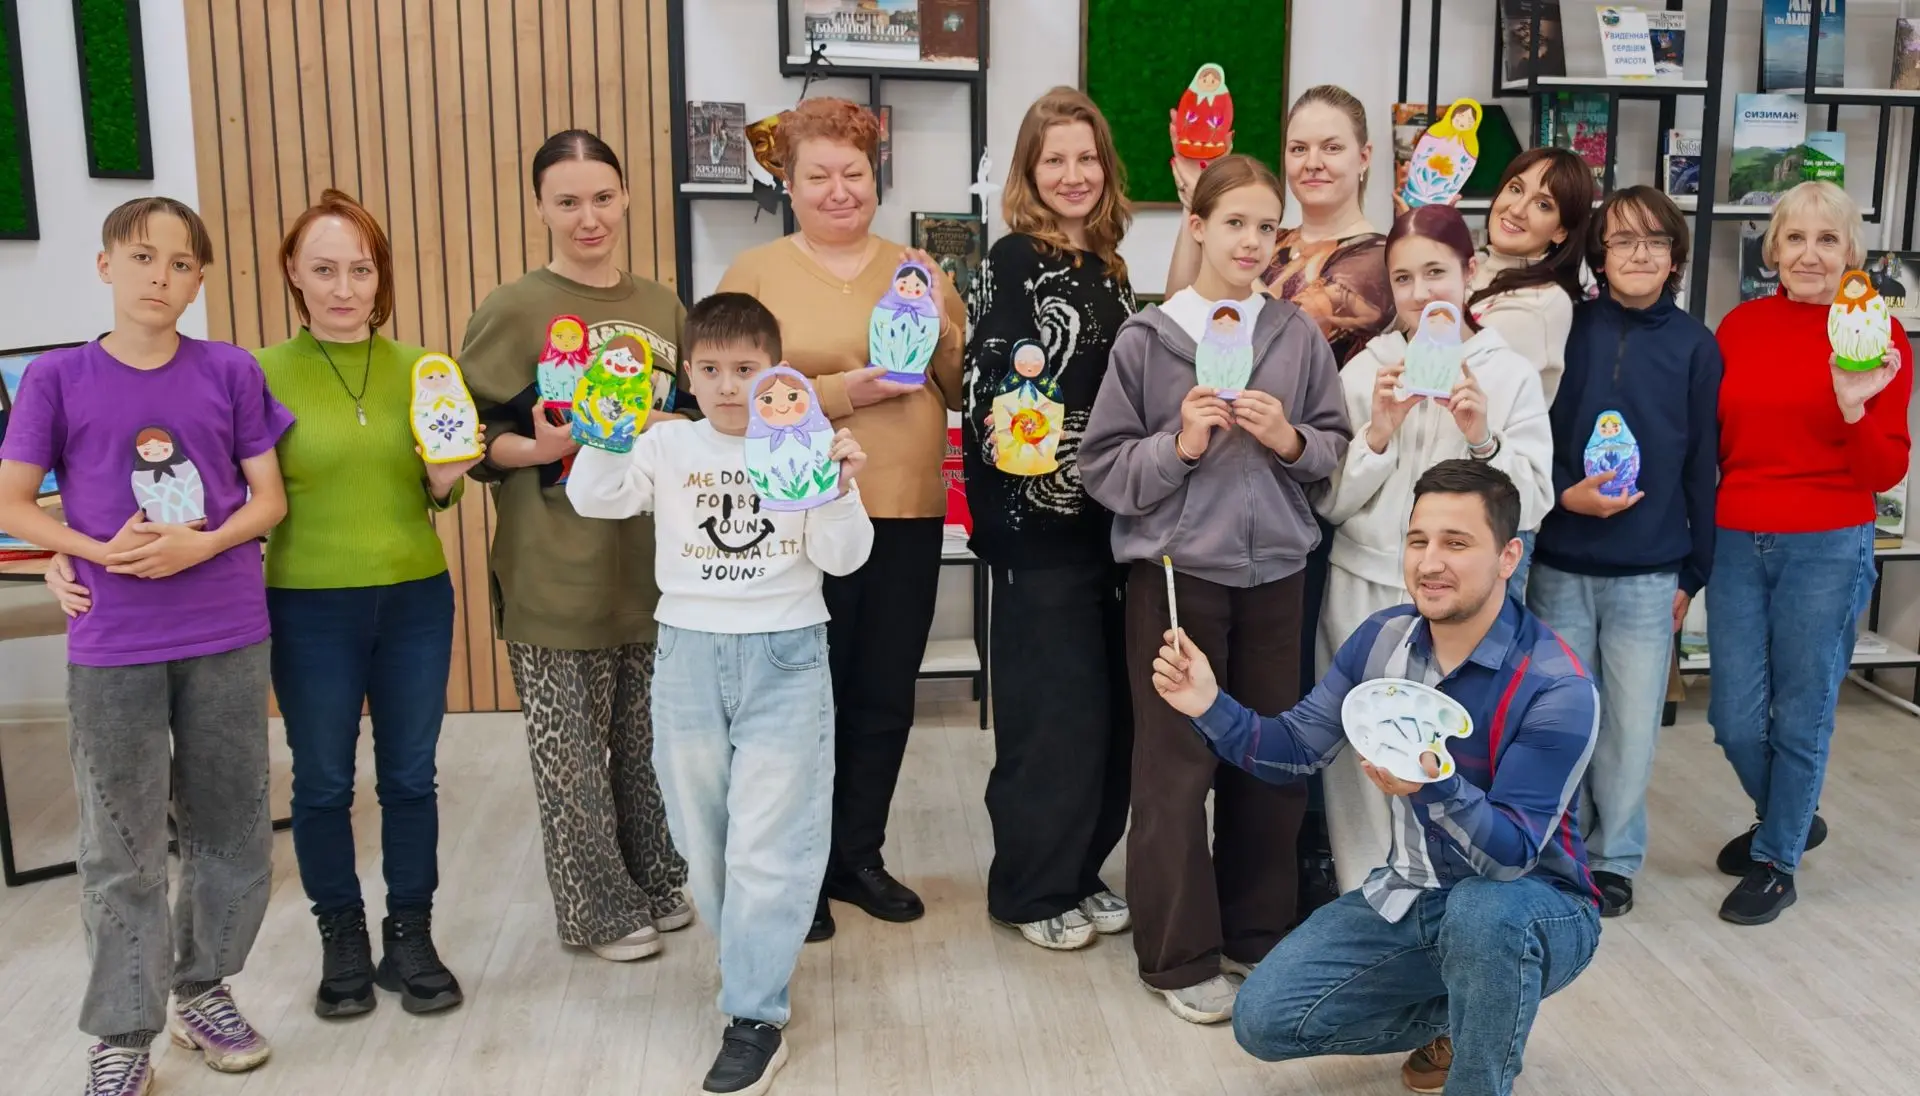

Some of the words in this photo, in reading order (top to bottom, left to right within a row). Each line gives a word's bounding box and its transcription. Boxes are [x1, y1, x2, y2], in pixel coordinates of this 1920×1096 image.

[1604, 31, 1649, 40] УВИДЕННАЯ
[1612, 44, 1646, 52] СЕРДЦЕМ
[1615, 57, 1647, 65] КРАСОТА
[1744, 110, 1800, 120] СИЗИМАН:
[721, 470, 751, 484] DO
[696, 493, 734, 509] FO
